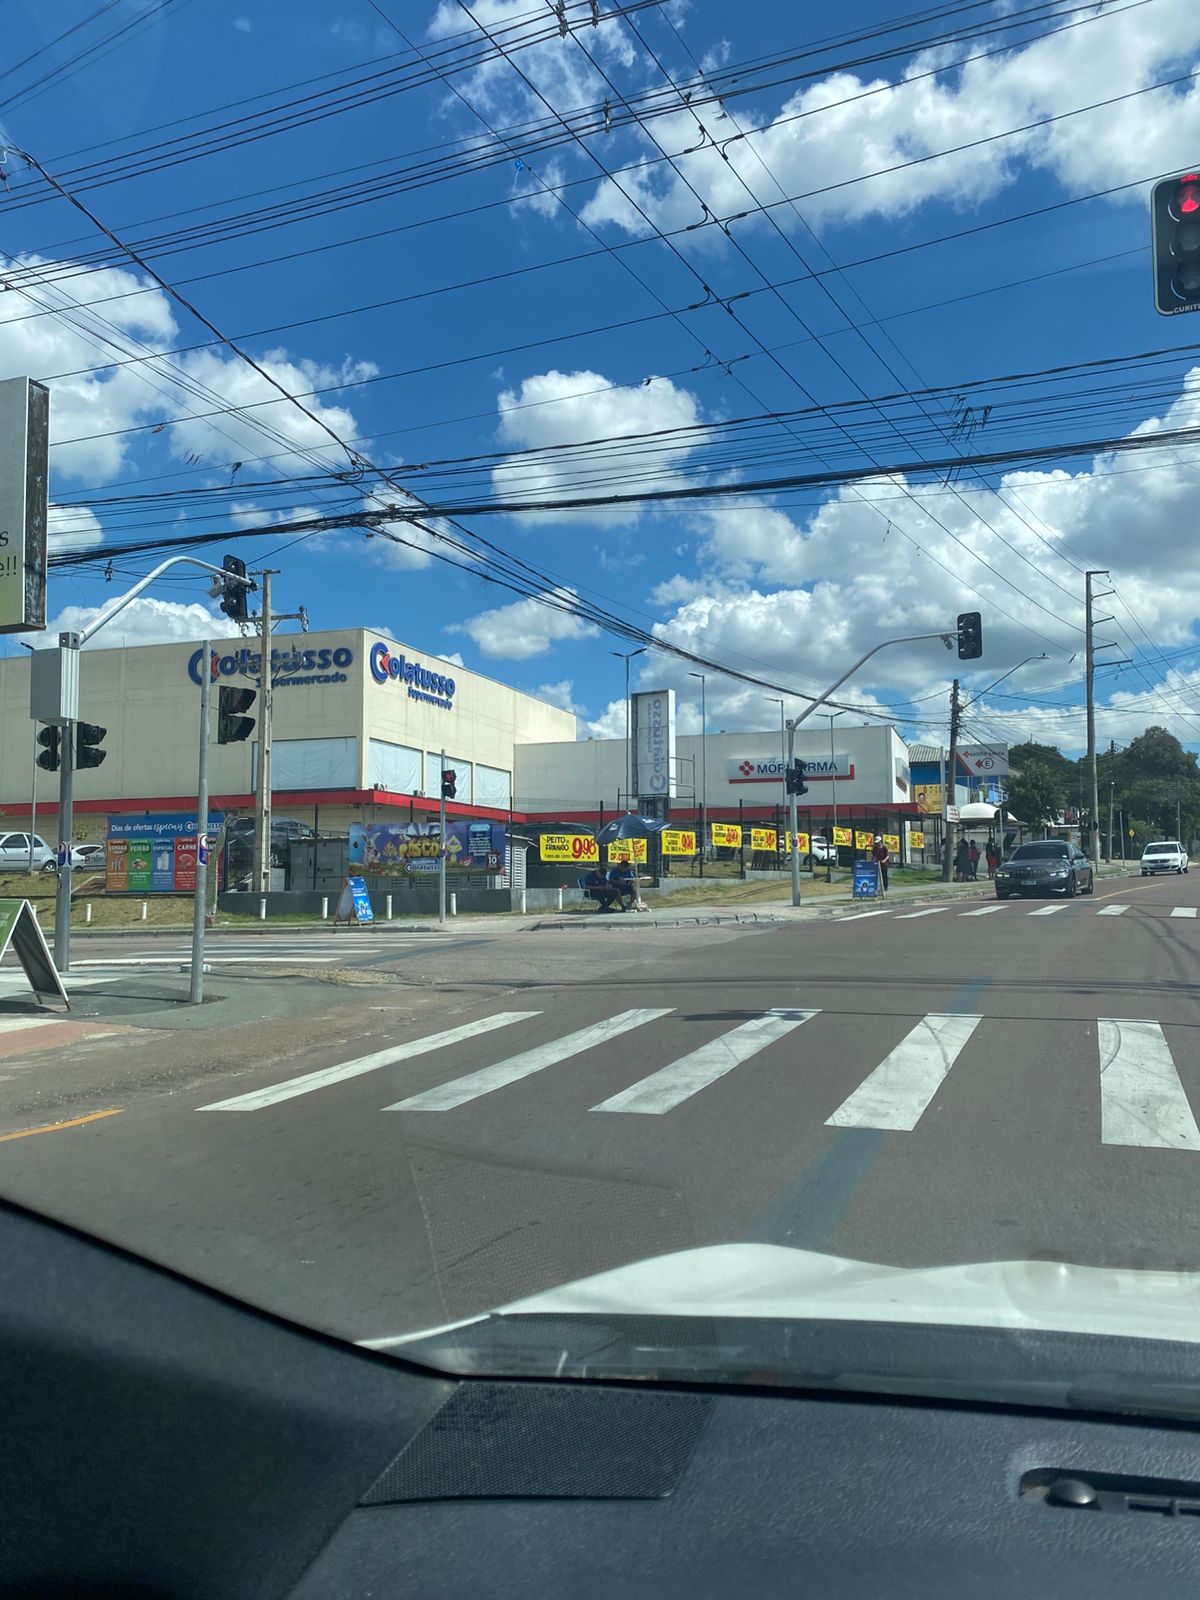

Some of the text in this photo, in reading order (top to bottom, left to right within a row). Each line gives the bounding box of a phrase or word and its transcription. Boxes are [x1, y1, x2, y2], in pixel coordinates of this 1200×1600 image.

[370, 642, 456, 698] Colatusso
[255, 672, 348, 690] Spermercado
[757, 761, 838, 774] MORIRMA
[111, 824, 123, 832] Dias
[124, 823, 132, 831] de
[133, 823, 153, 831] ofertas
[546, 836, 566, 844] PEITO
